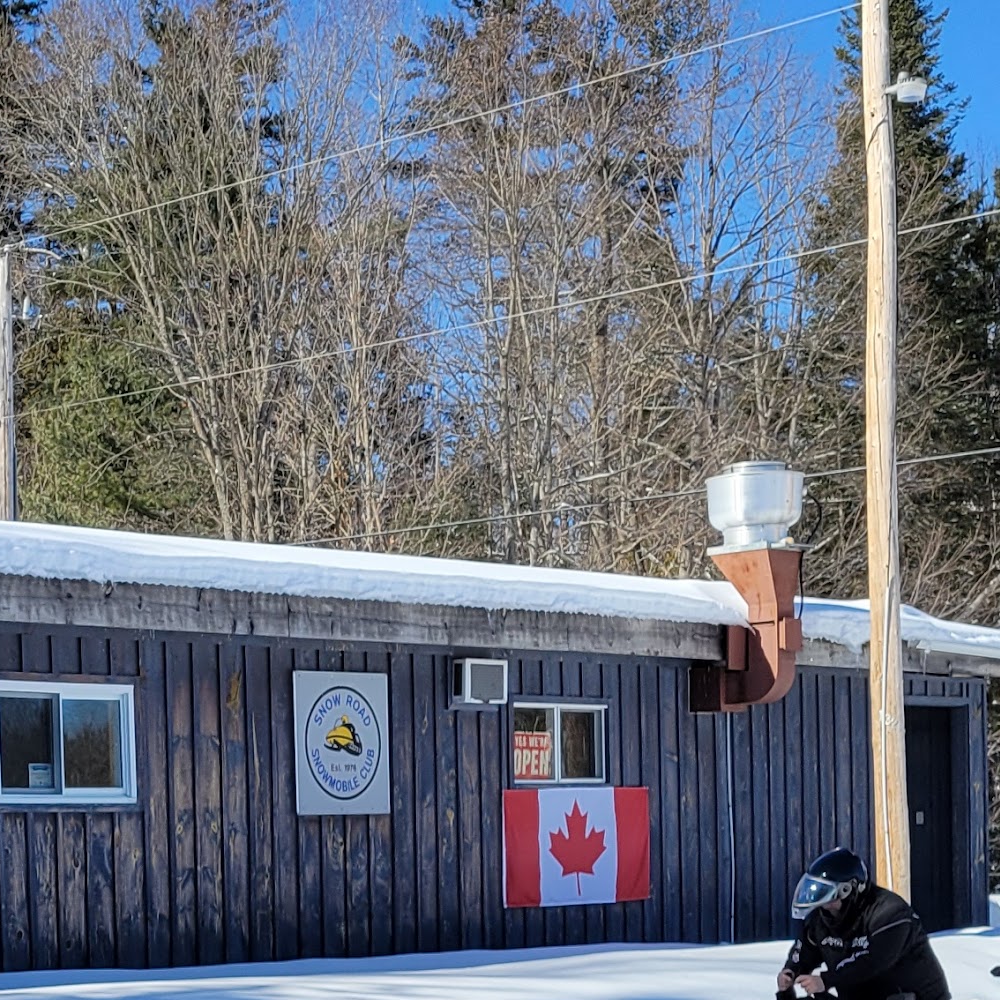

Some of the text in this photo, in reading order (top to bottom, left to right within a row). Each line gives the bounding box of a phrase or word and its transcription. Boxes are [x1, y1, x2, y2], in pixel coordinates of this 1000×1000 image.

[314, 694, 371, 727] SNOW ROAD
[515, 735, 527, 747] YES
[311, 748, 375, 792] SNOWMOBILE CLUB
[514, 748, 549, 775] OPEN
